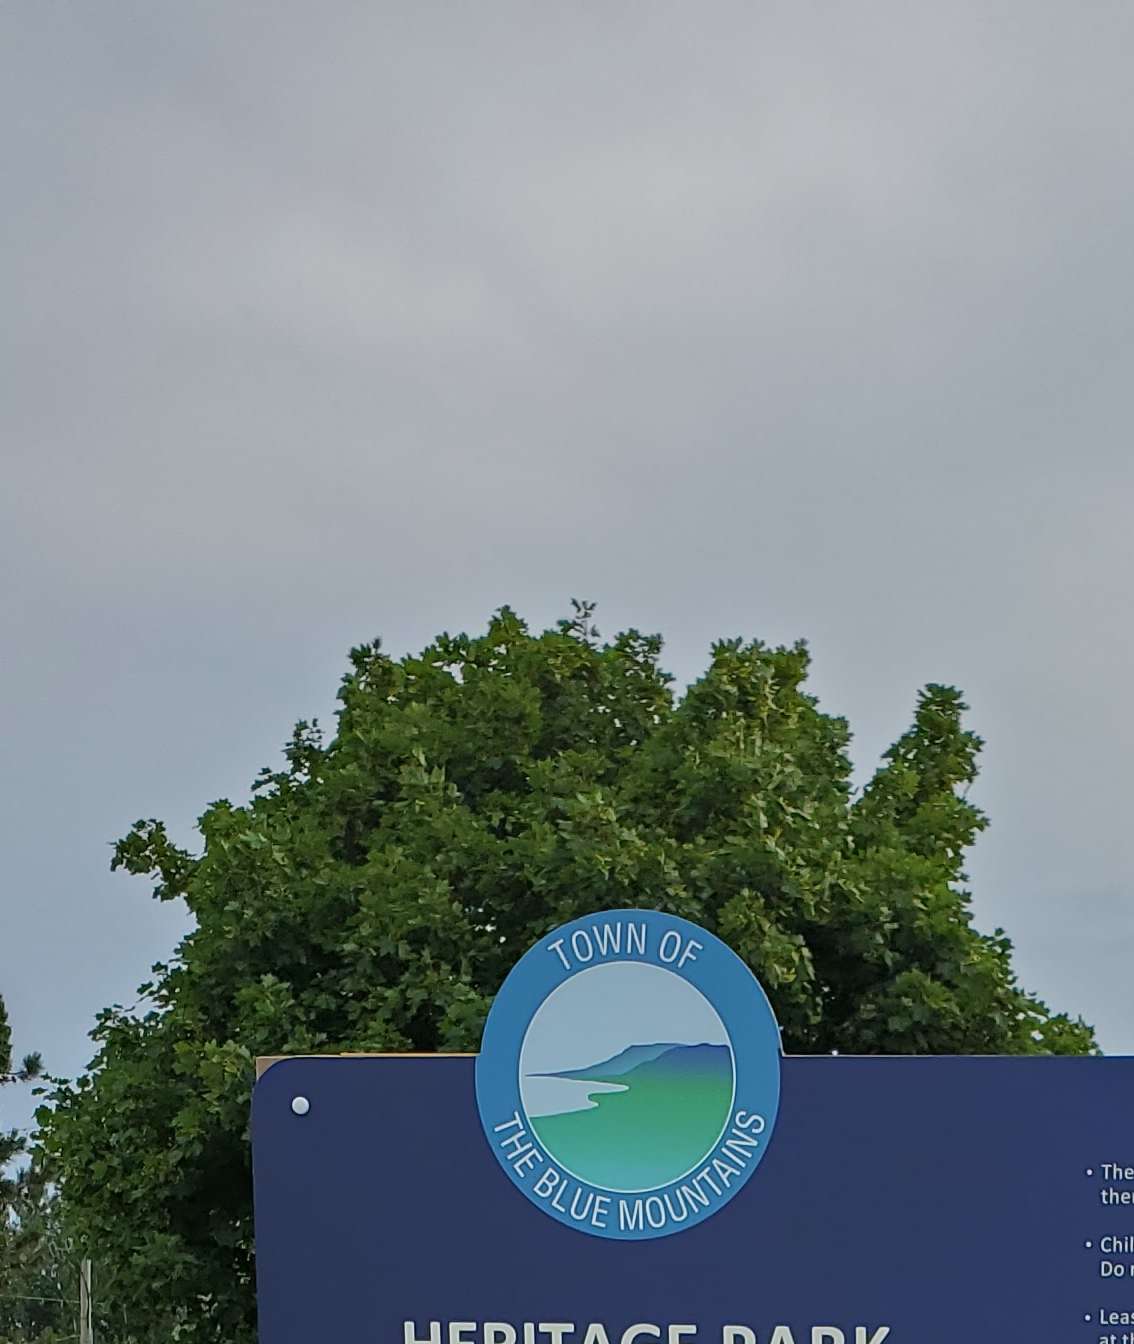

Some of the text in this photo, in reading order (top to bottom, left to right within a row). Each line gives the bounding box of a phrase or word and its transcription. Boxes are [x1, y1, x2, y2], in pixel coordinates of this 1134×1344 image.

[547, 922, 704, 971] TOWN OF
[494, 1110, 766, 1231] THE BLUE MOUNTAINS
[1101, 1163, 1134, 1179] The
